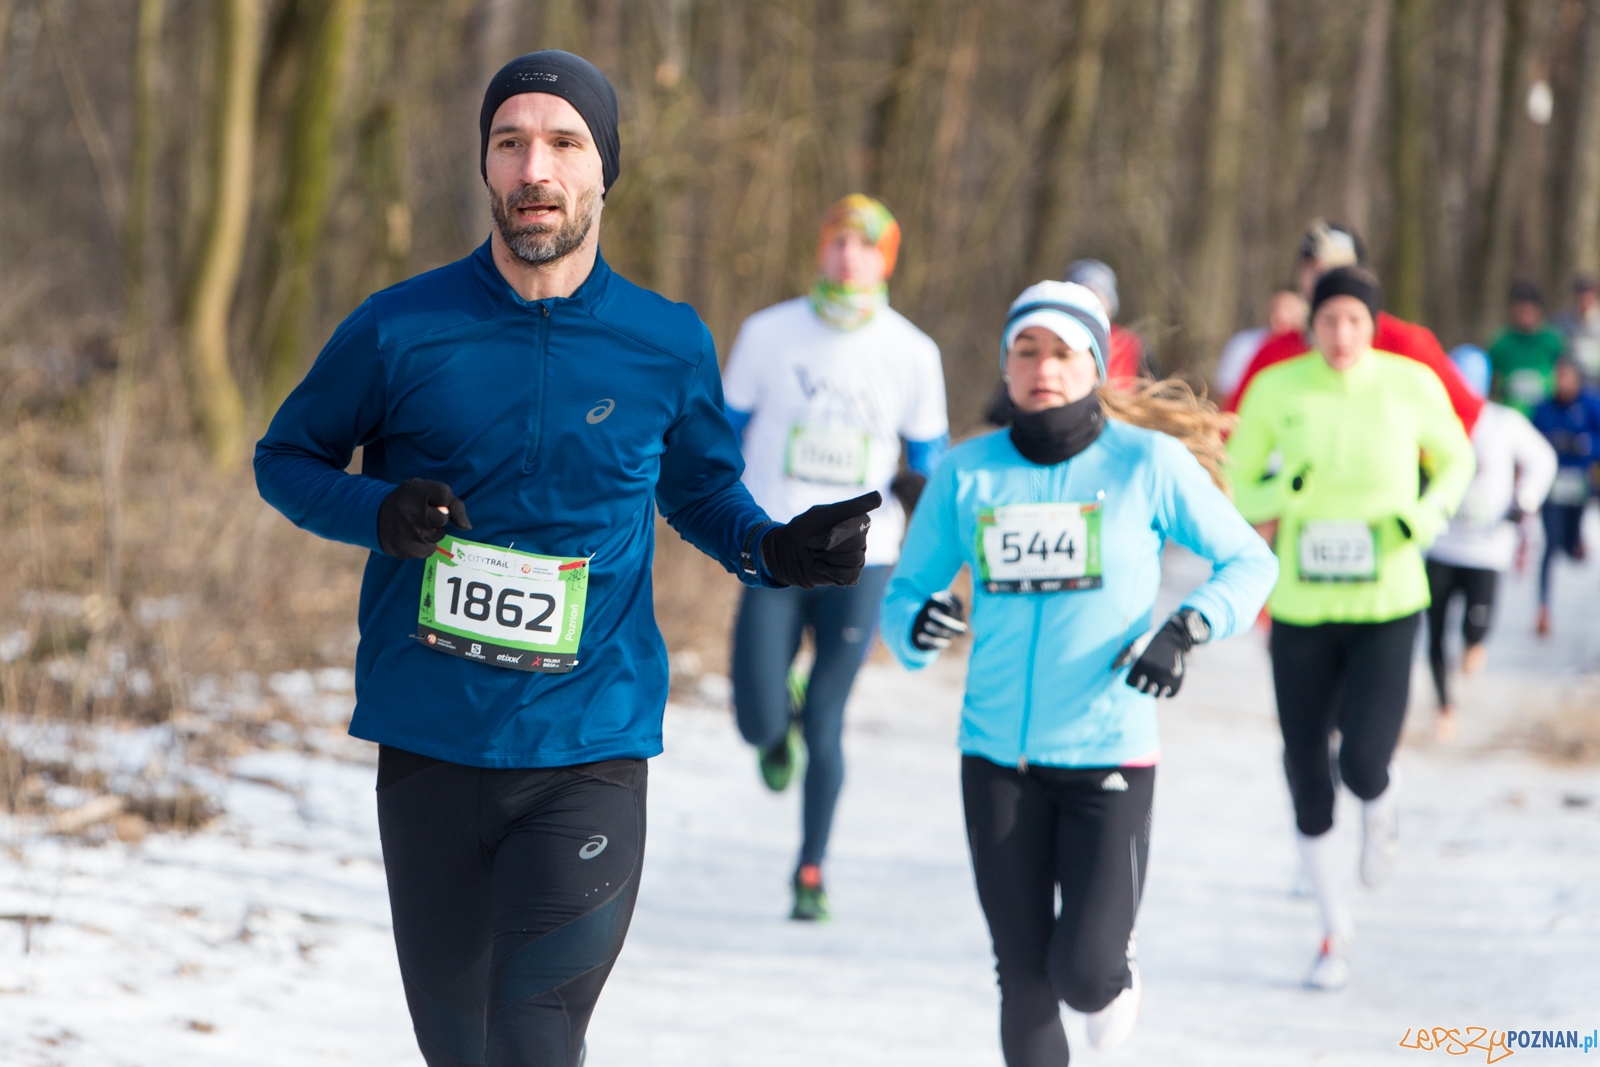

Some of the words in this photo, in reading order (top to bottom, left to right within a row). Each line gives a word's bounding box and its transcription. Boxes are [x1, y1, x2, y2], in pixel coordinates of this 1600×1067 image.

[1002, 530, 1076, 563] 544
[447, 576, 556, 633] 1862
[565, 604, 579, 641] Poznań
